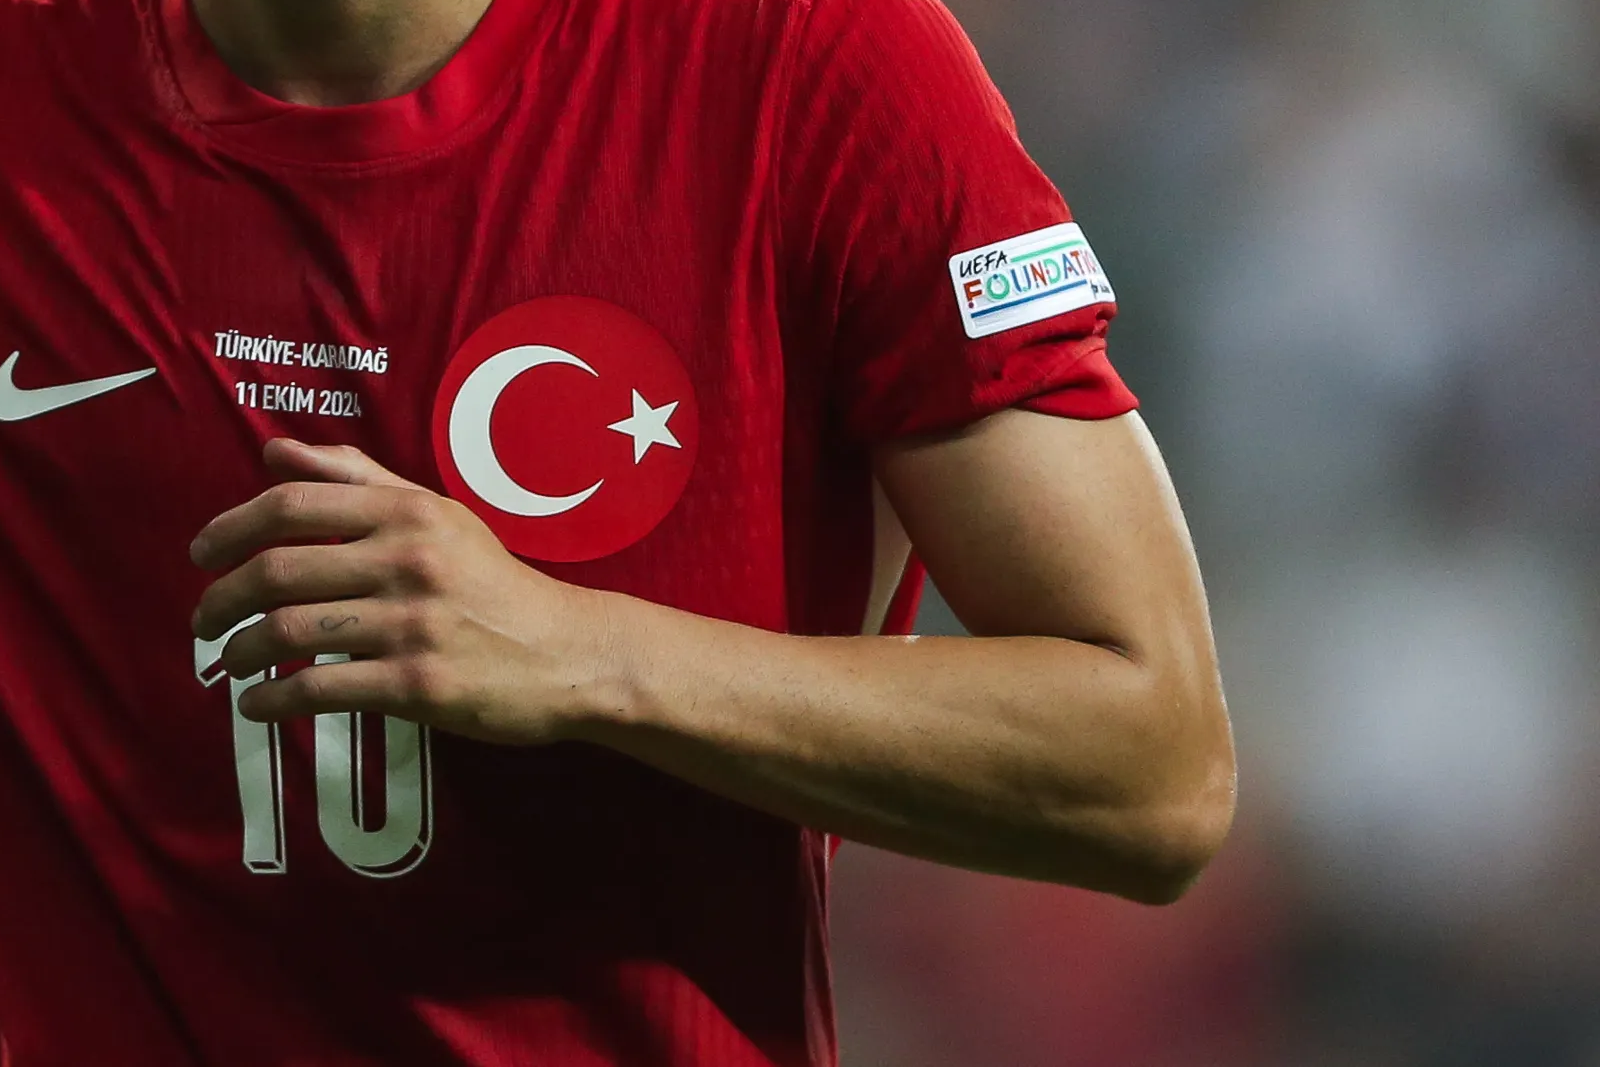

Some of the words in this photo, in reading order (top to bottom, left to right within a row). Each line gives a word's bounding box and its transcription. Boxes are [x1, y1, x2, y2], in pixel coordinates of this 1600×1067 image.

[959, 250, 1008, 278] UEFA
[214, 329, 389, 374] TÜRKİYE-KARADAĞ
[235, 381, 259, 408] 11
[262, 381, 315, 414] EKİM
[318, 389, 362, 418] 2024
[193, 612, 434, 879] 10
